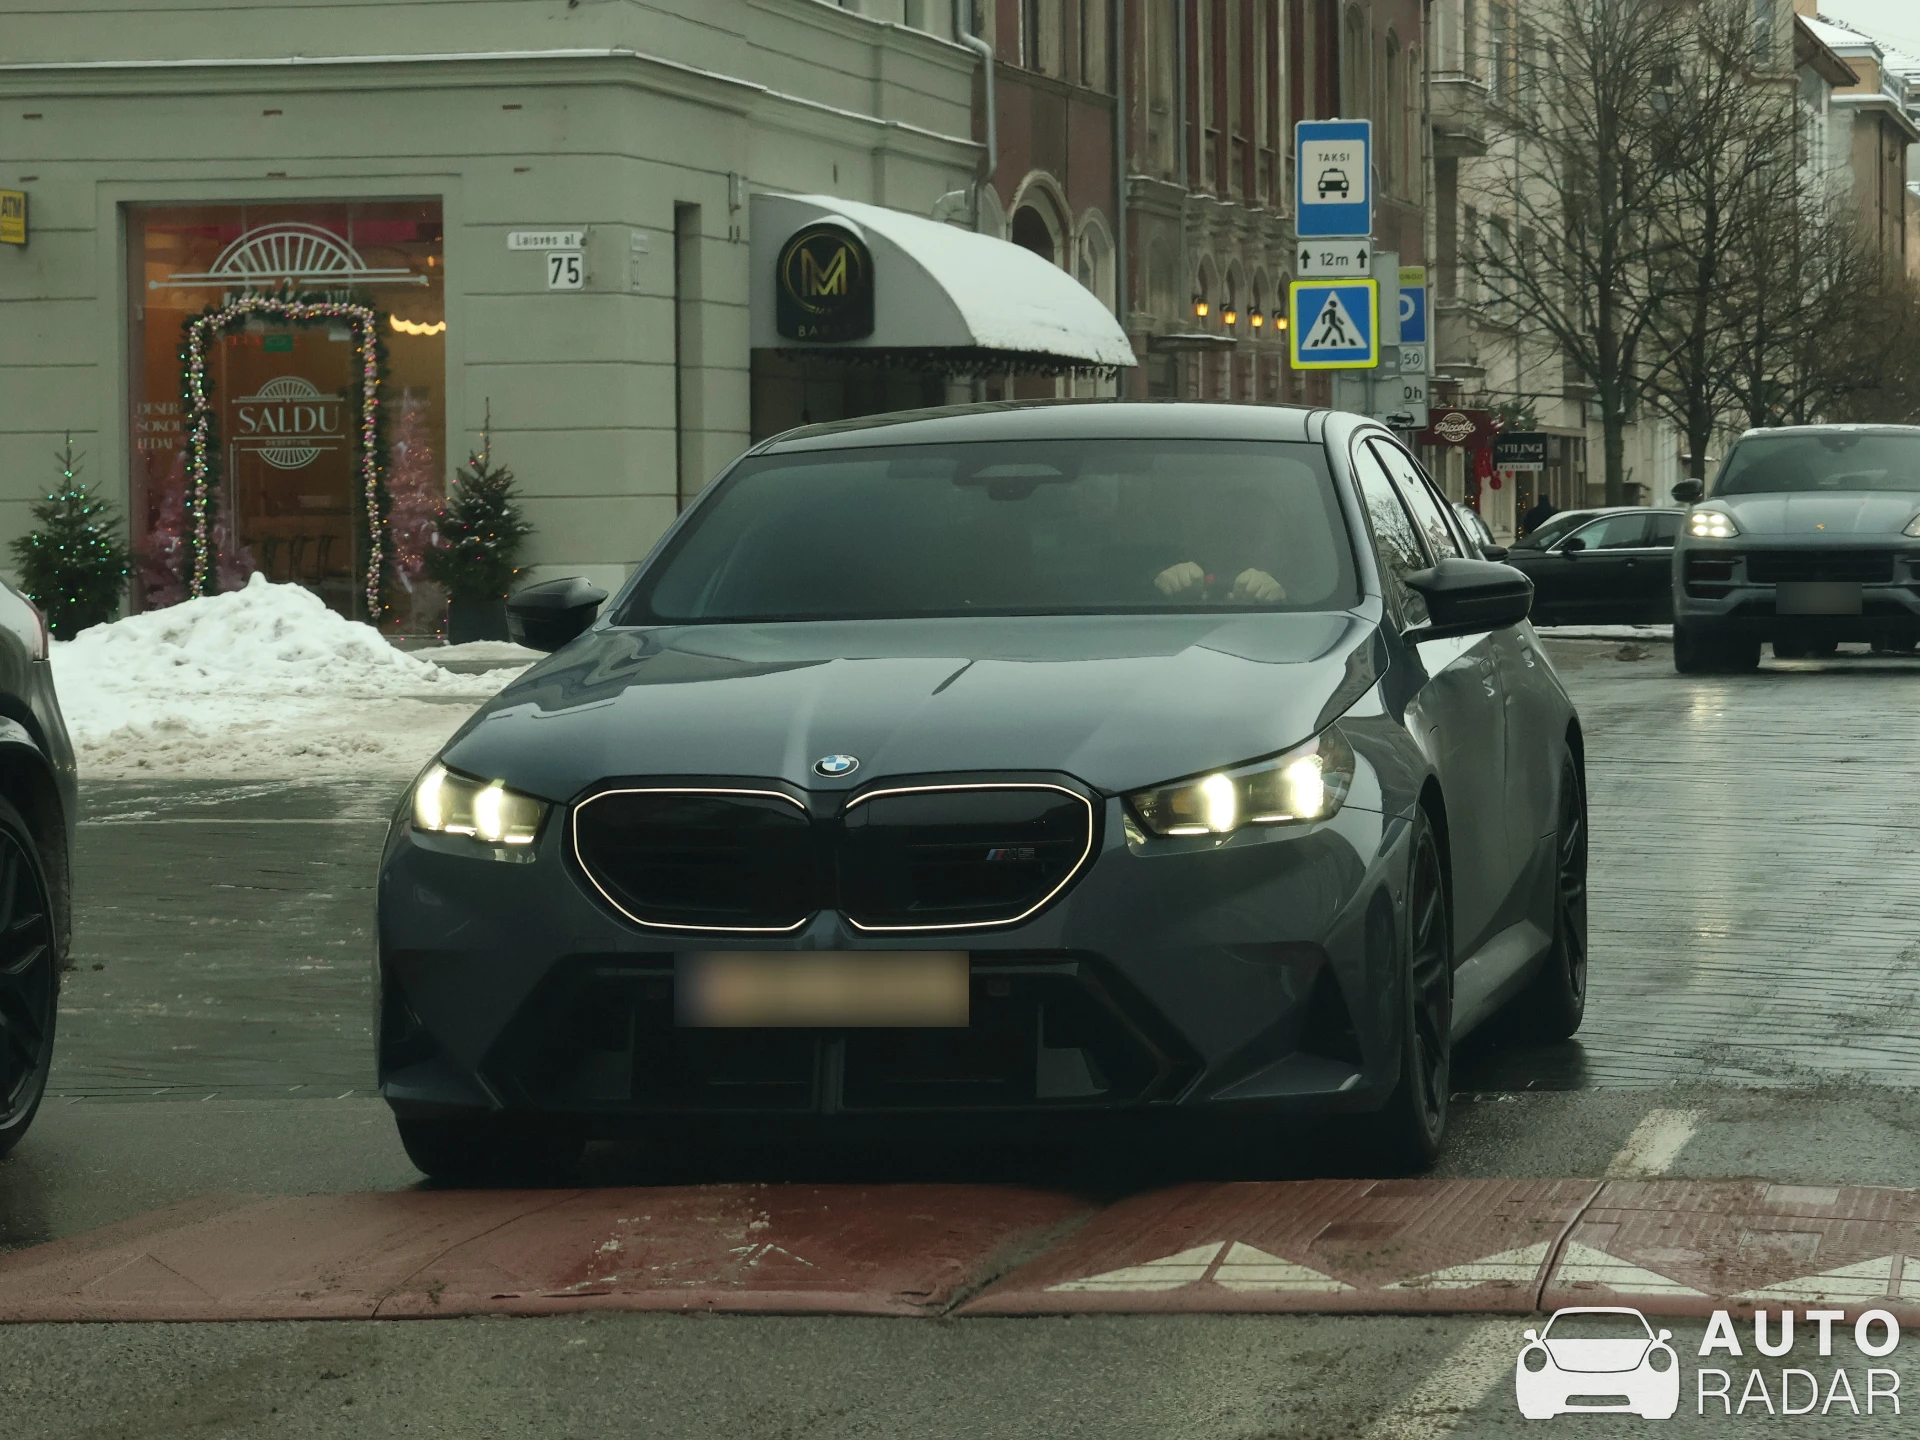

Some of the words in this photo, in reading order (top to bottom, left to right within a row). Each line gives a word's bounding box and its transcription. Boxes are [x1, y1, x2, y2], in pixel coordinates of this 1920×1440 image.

[1318, 153, 1350, 162] TAKSI
[1, 196, 22, 218] ATM
[551, 257, 580, 285] 75
[239, 406, 339, 433] SALDU
[1434, 420, 1476, 435] Piccola
